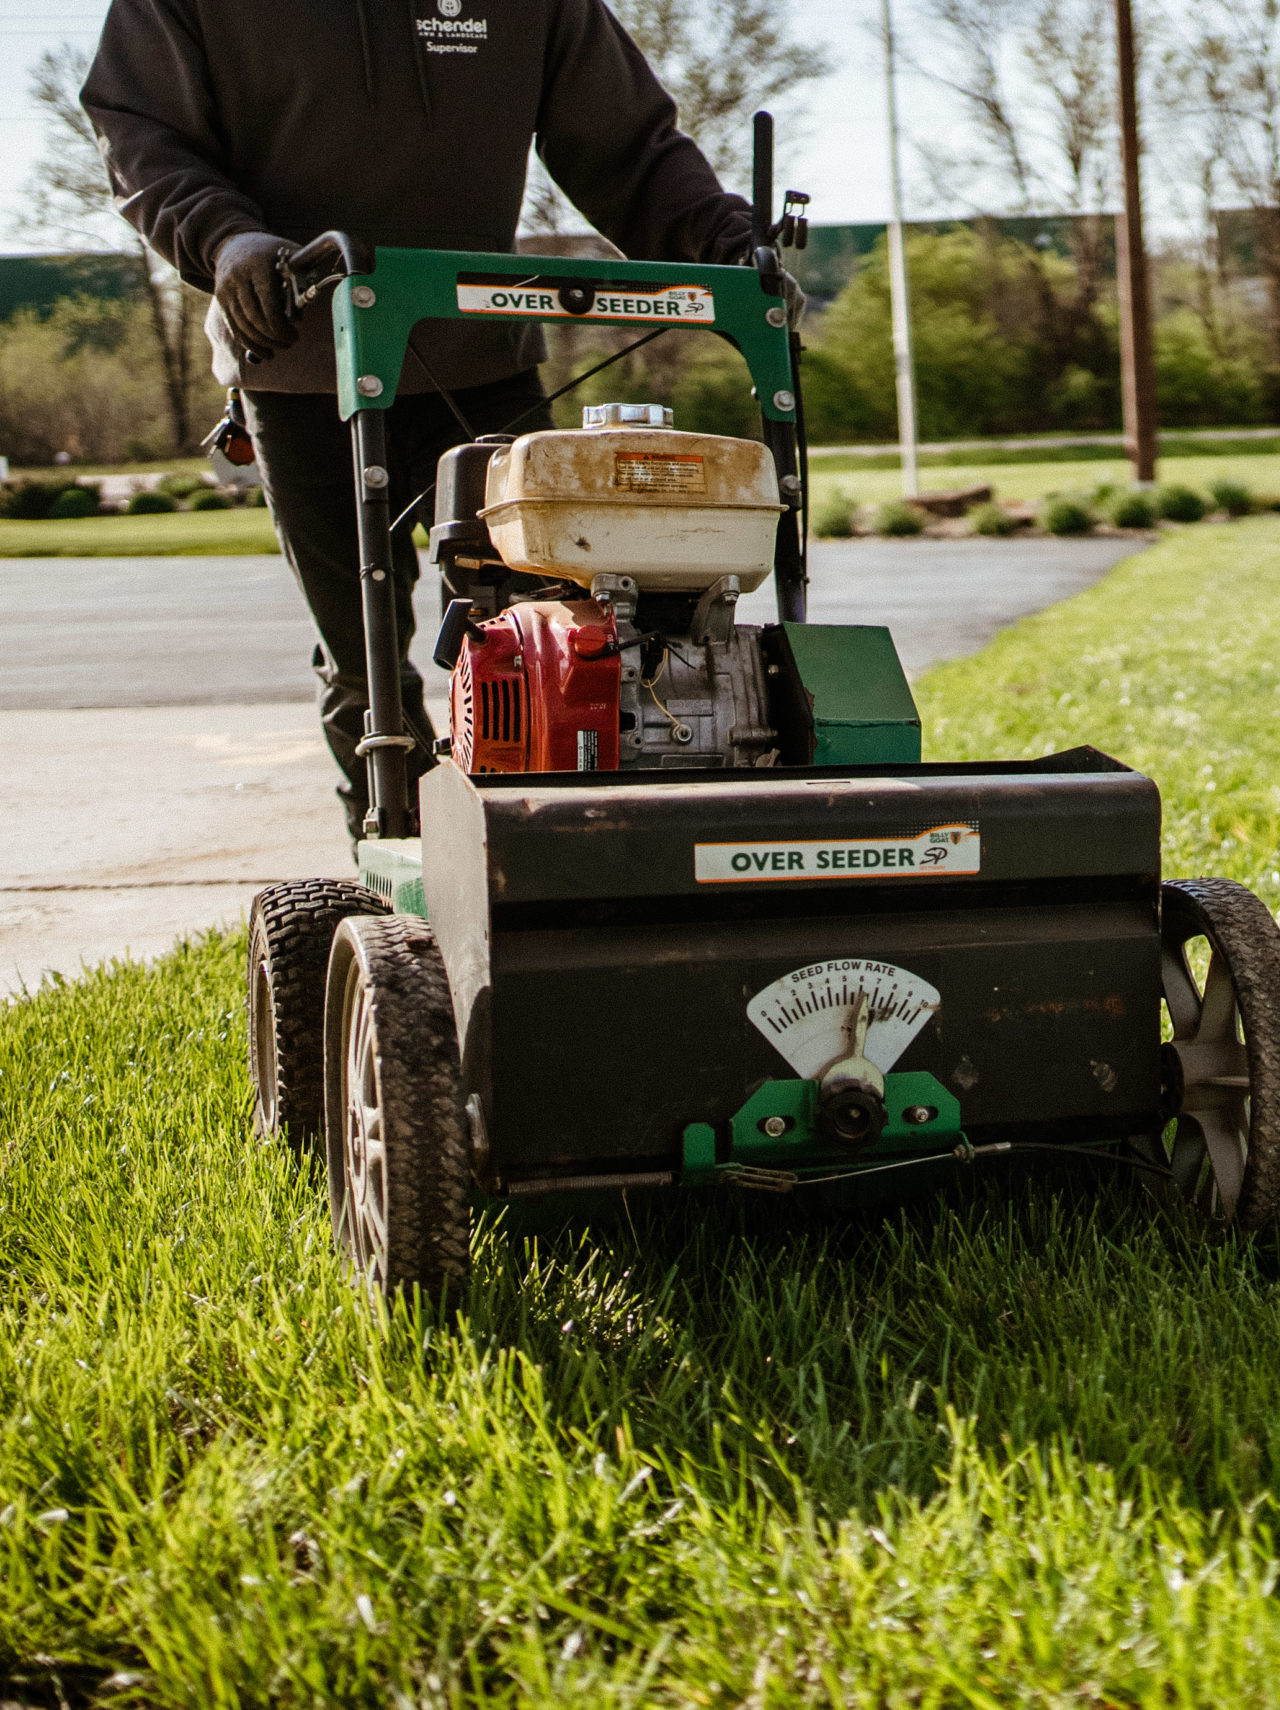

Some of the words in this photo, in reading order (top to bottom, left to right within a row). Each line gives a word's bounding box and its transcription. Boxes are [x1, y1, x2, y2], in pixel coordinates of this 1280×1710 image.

[426, 41, 478, 54] Supervisor
[490, 292, 555, 310] OVER
[596, 297, 682, 316] SEEDER
[731, 851, 804, 872] OVER
[816, 848, 915, 869] SEEDER
[919, 846, 948, 865] SP
[791, 965, 823, 983] SEED
[827, 961, 861, 972] FLOW
[865, 962, 896, 977] RATE
[761, 1010, 768, 1018] 0
[919, 999, 929, 1008] 10
